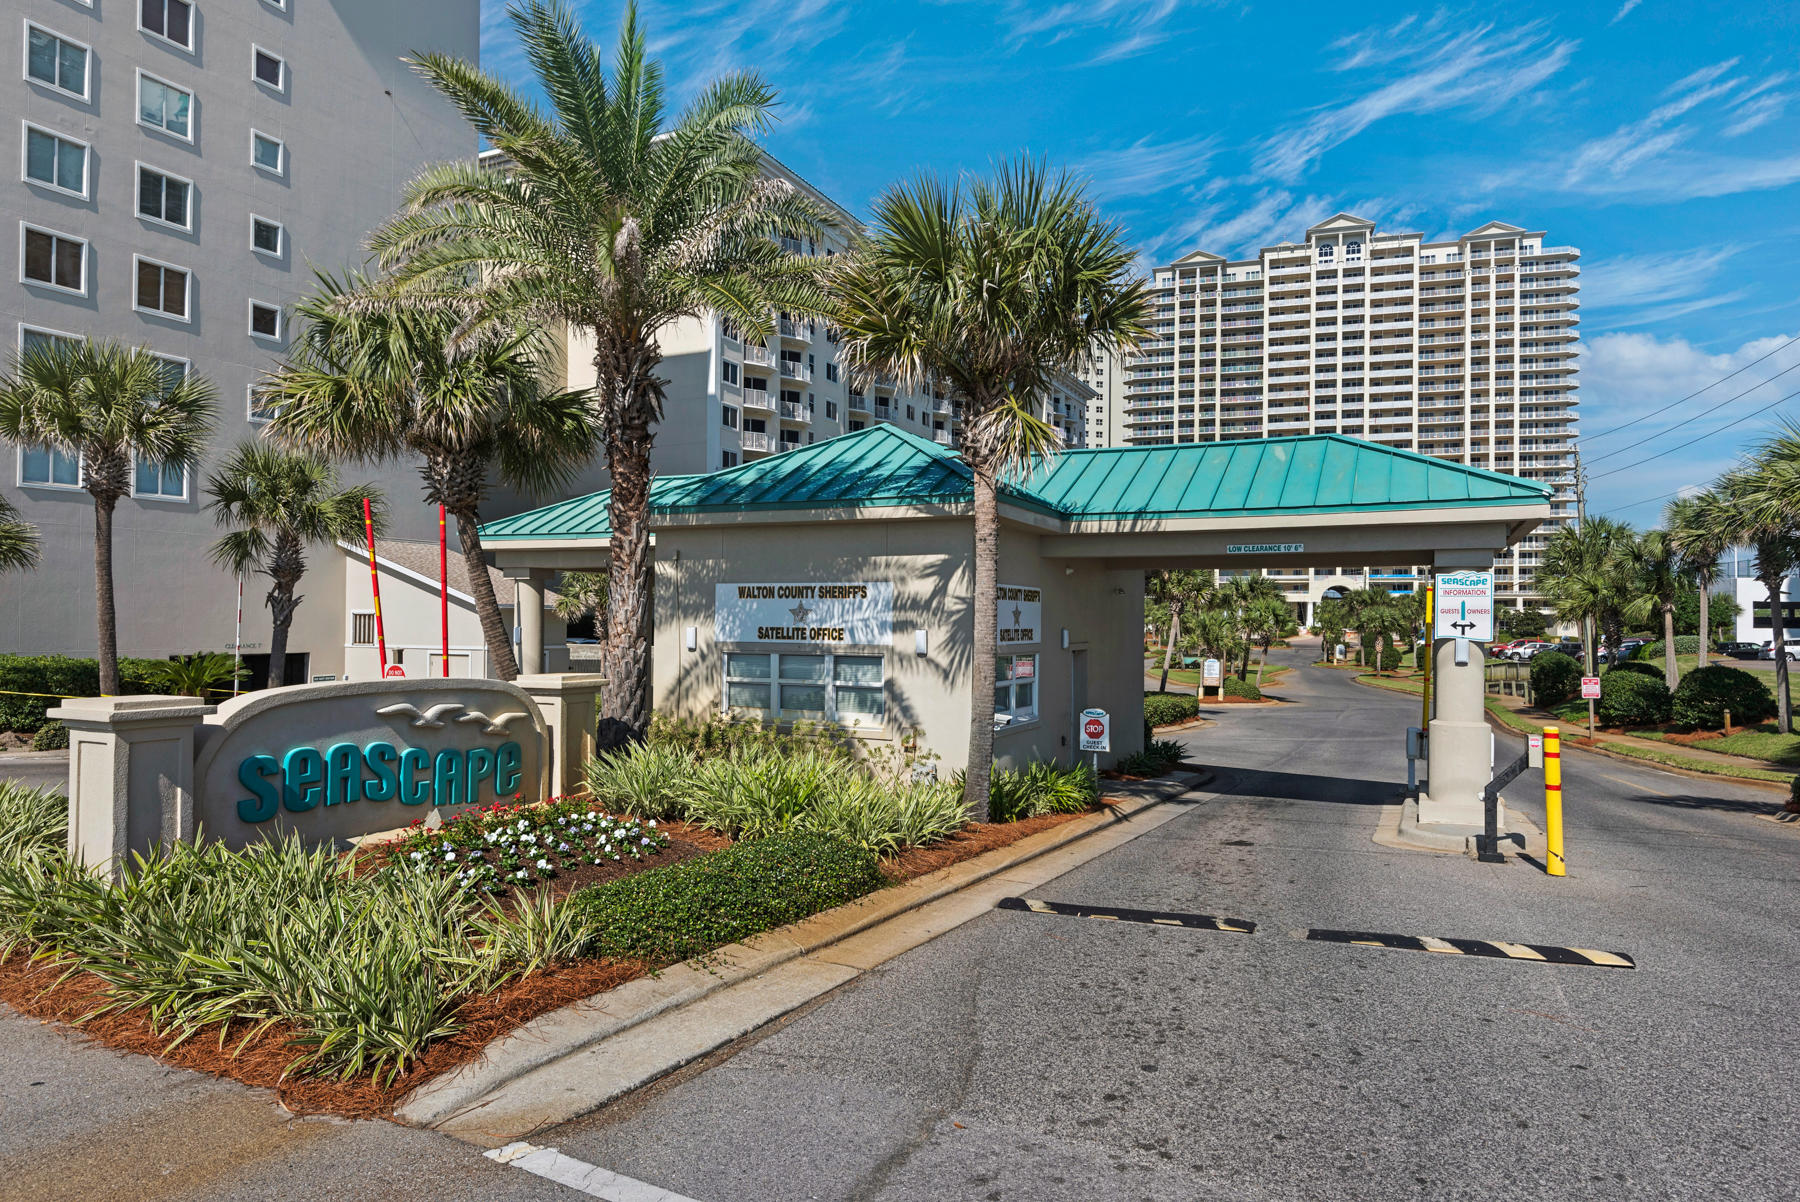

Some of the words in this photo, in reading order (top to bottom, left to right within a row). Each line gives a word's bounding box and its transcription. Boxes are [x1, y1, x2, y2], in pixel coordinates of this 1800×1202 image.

[1228, 545, 1242, 553] LOW
[738, 586, 775, 599] WALTON
[777, 586, 816, 599] COUNTY
[818, 585, 867, 599] SHERIFF'S
[1008, 587, 1022, 602] COUNTY
[1024, 589, 1040, 602] SHERIFF'S
[757, 626, 807, 640] SATELLITE
[809, 627, 844, 641] OFFICE
[1000, 628, 1019, 641] SATELLITE
[1020, 628, 1033, 641] OFFICE
[1086, 725, 1103, 733] STOP
